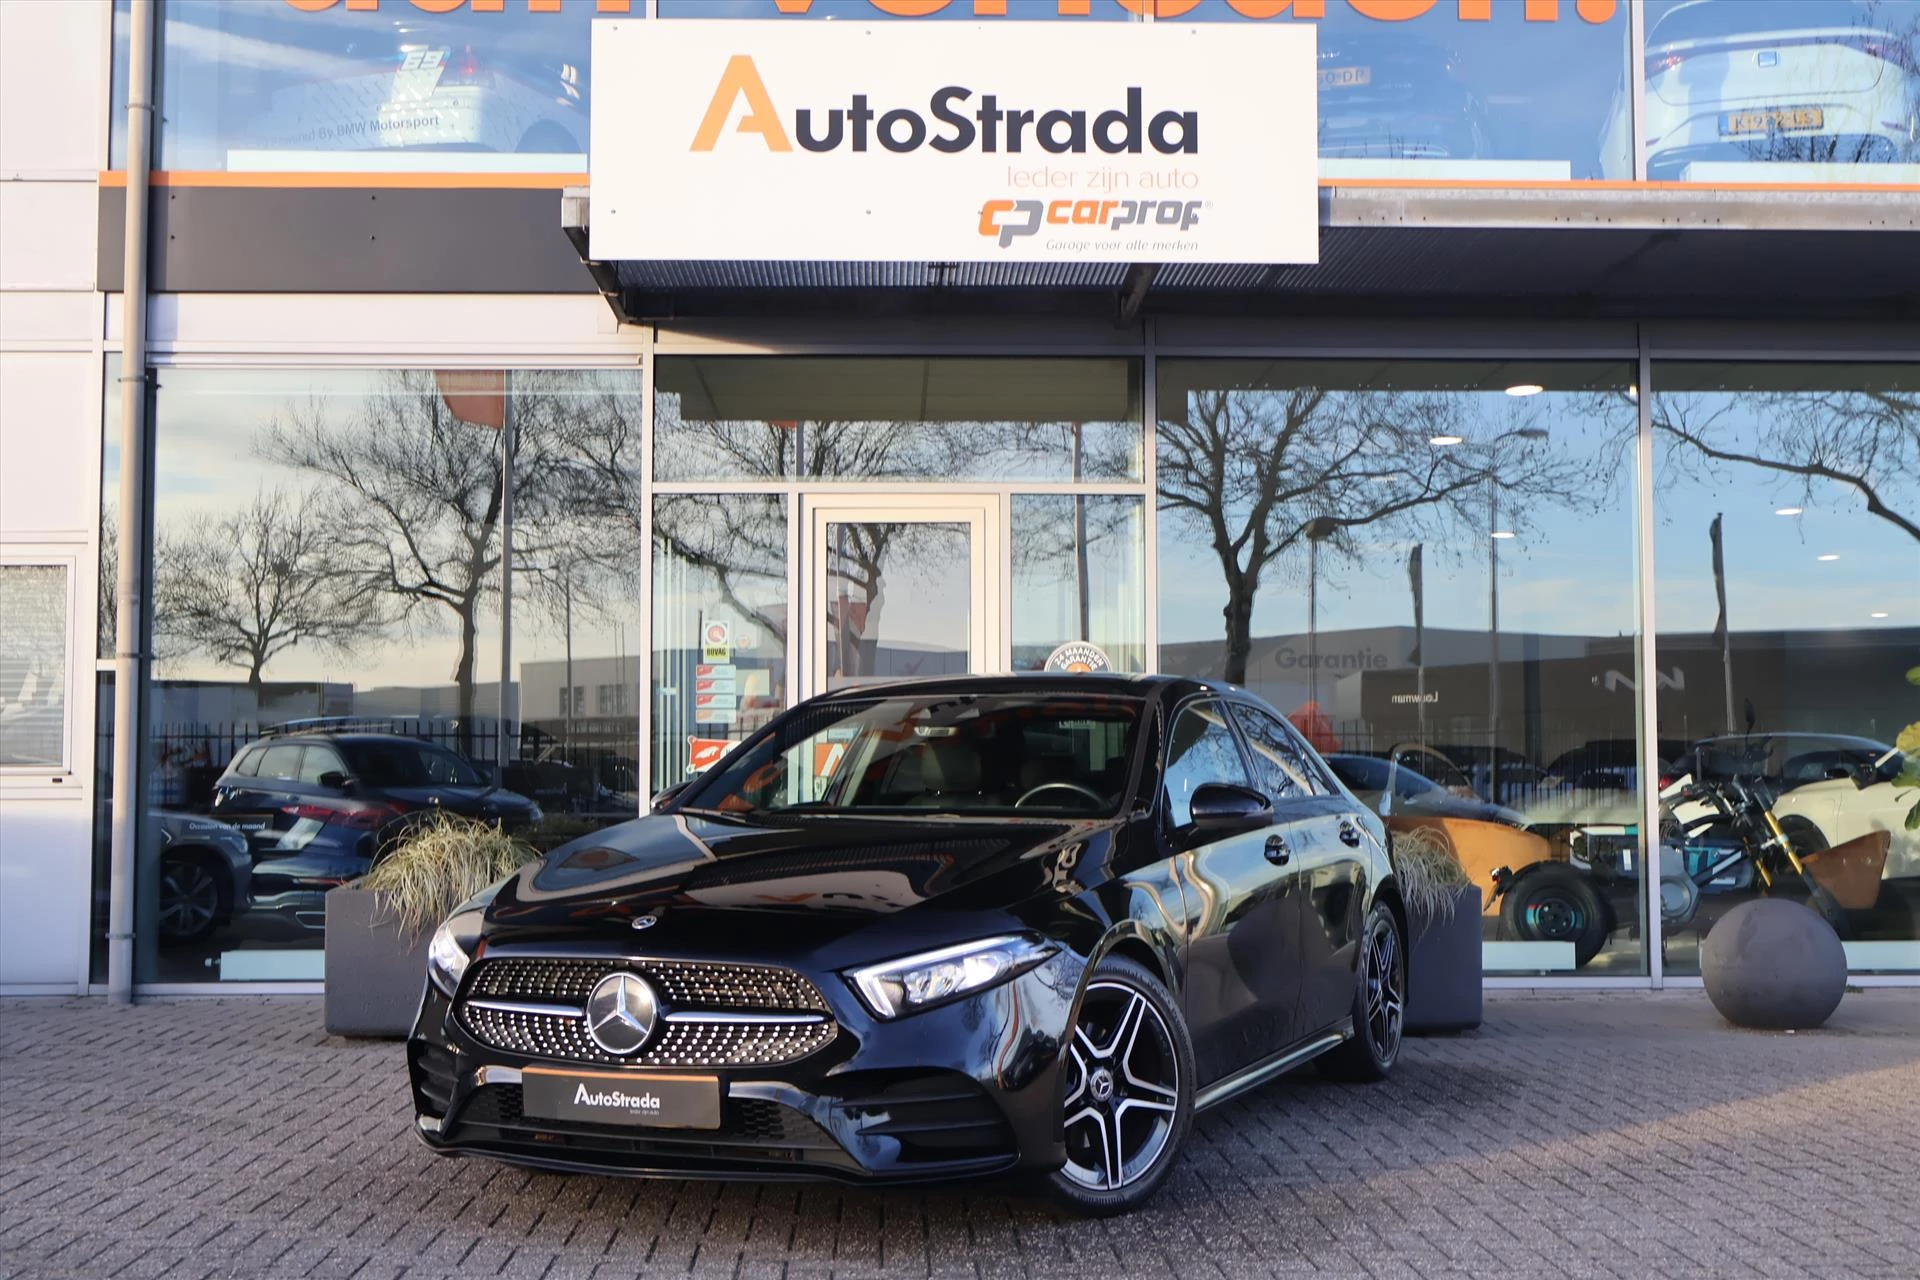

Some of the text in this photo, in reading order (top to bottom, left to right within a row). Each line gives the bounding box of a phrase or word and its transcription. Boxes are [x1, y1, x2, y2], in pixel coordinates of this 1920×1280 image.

[688, 54, 1200, 156] AutoStrada
[336, 120, 366, 137] BMW
[370, 115, 440, 133] Motorsport
[1007, 165, 1199, 192] Ieder zijn auto
[1046, 238, 1199, 252] Garage voor alle merken
[1060, 655, 1098, 671] GARANTIE
[1065, 646, 1105, 667] MAANDEN
[1274, 647, 1388, 669] Garantie
[573, 1082, 661, 1109] AutoStrada
